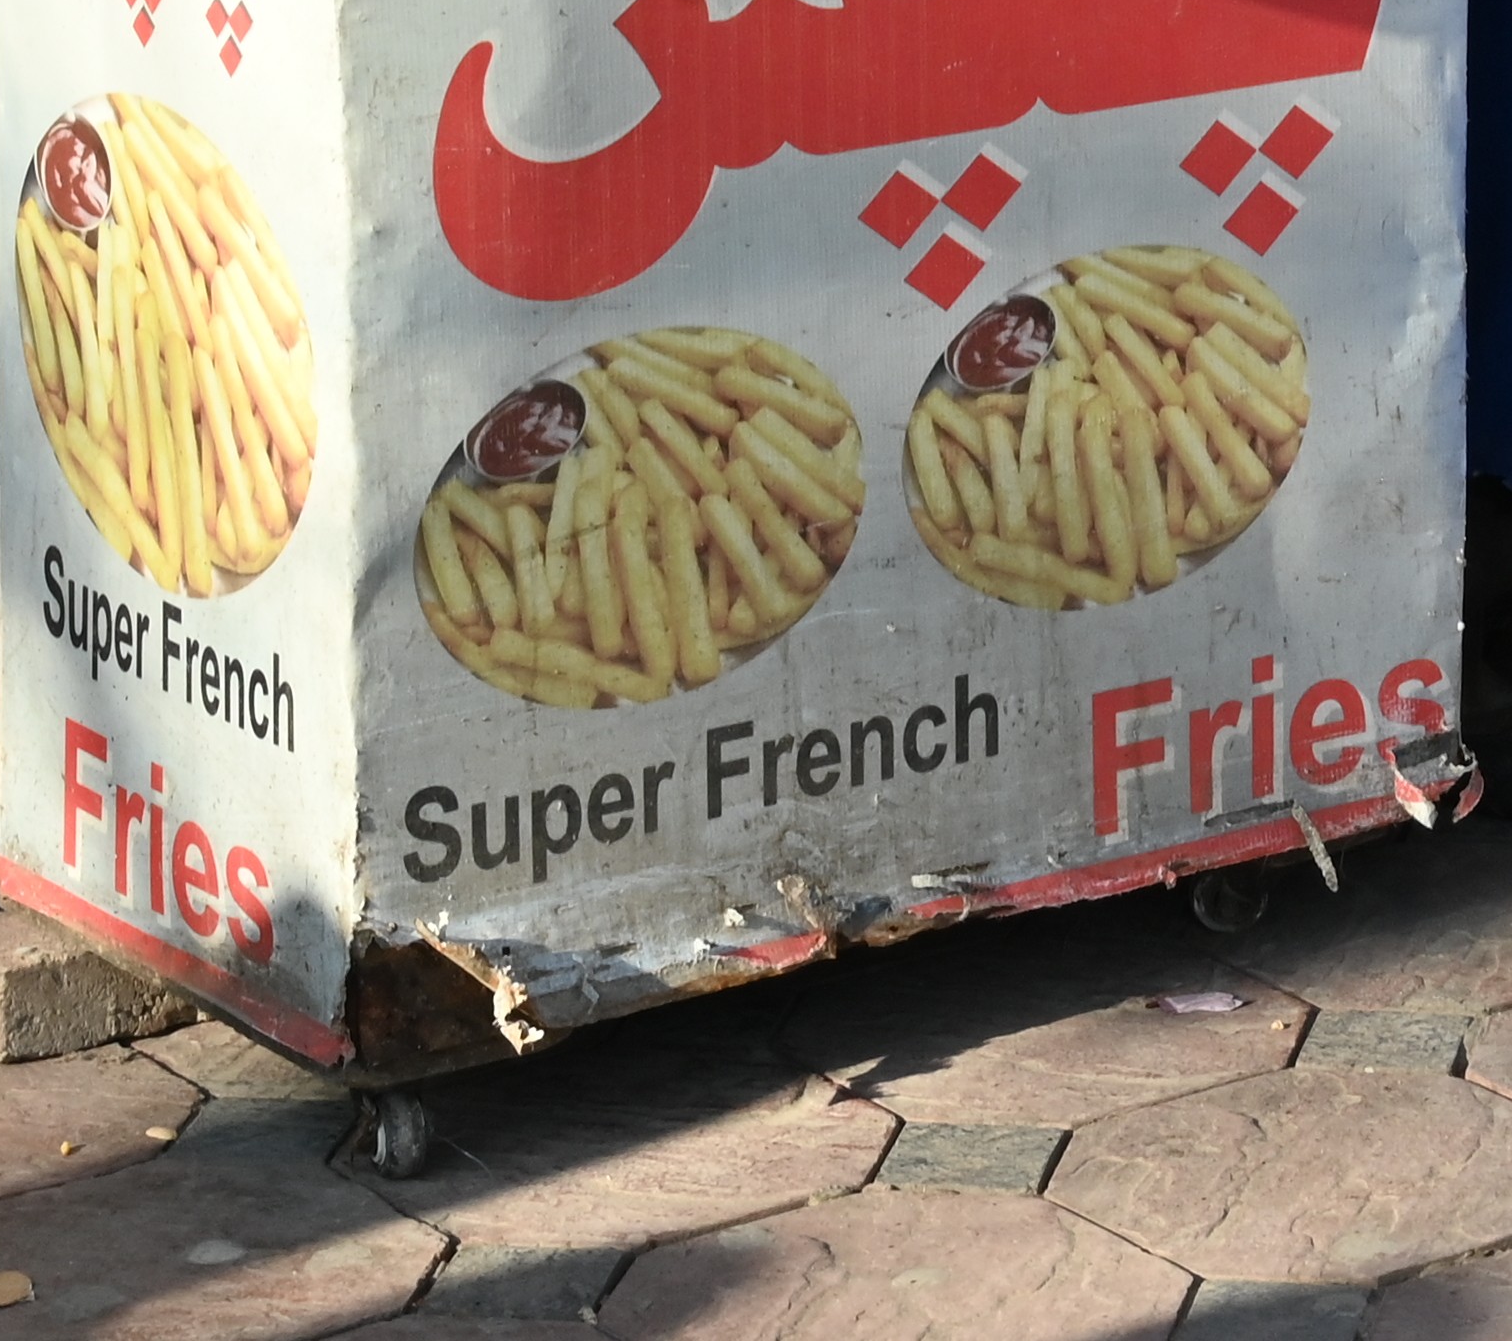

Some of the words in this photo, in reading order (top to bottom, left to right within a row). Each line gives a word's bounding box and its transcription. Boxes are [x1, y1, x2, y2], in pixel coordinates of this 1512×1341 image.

[43, 545, 150, 681] Super
[162, 601, 296, 753] French
[1093, 653, 1447, 838] Fries
[62, 716, 275, 967] Fries
[403, 757, 676, 885] Super
[705, 674, 1000, 820] French
